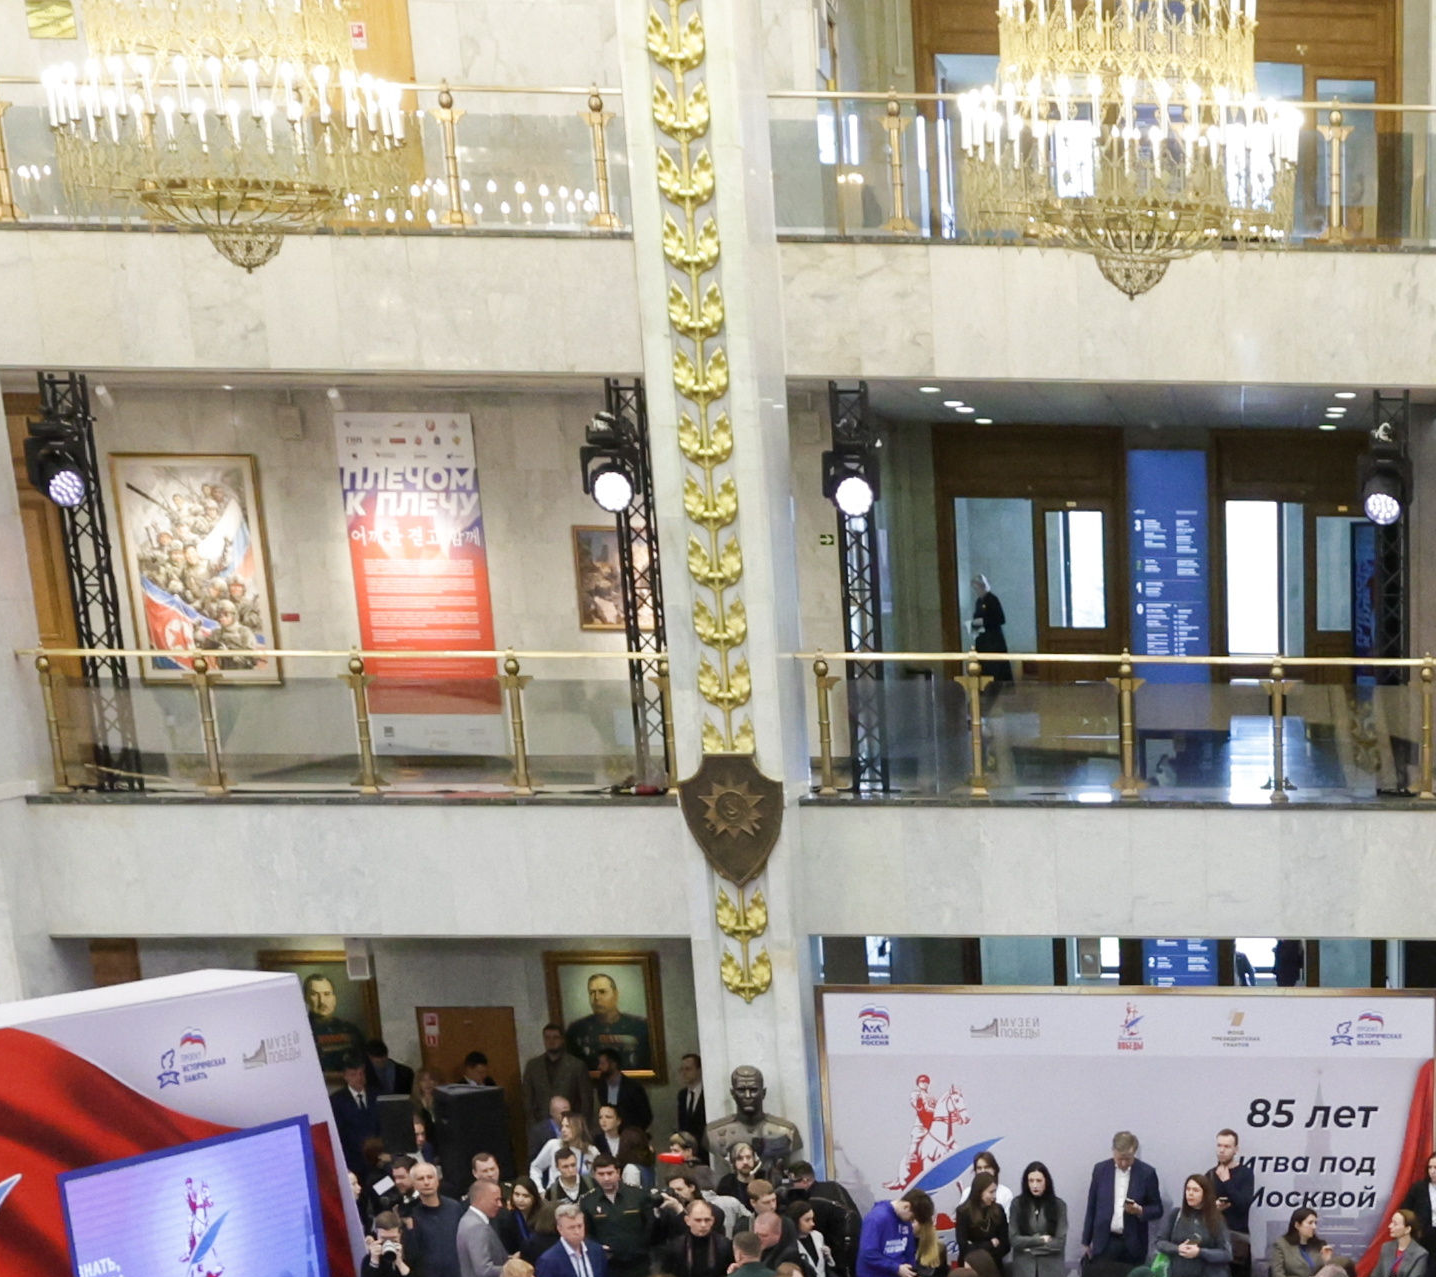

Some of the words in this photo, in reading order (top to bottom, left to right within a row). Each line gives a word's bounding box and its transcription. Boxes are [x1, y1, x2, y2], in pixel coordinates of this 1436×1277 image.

[343, 466, 475, 490] ПЛЕЧОМ
[345, 492, 366, 516] К
[375, 492, 478, 516] ПЛЕЧУ
[1135, 519, 1142, 531] 3
[1148, 957, 1155, 967] 2
[1000, 1017, 1040, 1027] МУЗЕЙ
[1000, 1028, 1040, 1039] ПОБЕДЫ
[1246, 1098, 1296, 1128] 85
[1304, 1105, 1379, 1128] лет
[1239, 1156, 1310, 1173] итва
[1319, 1157, 1375, 1176] под
